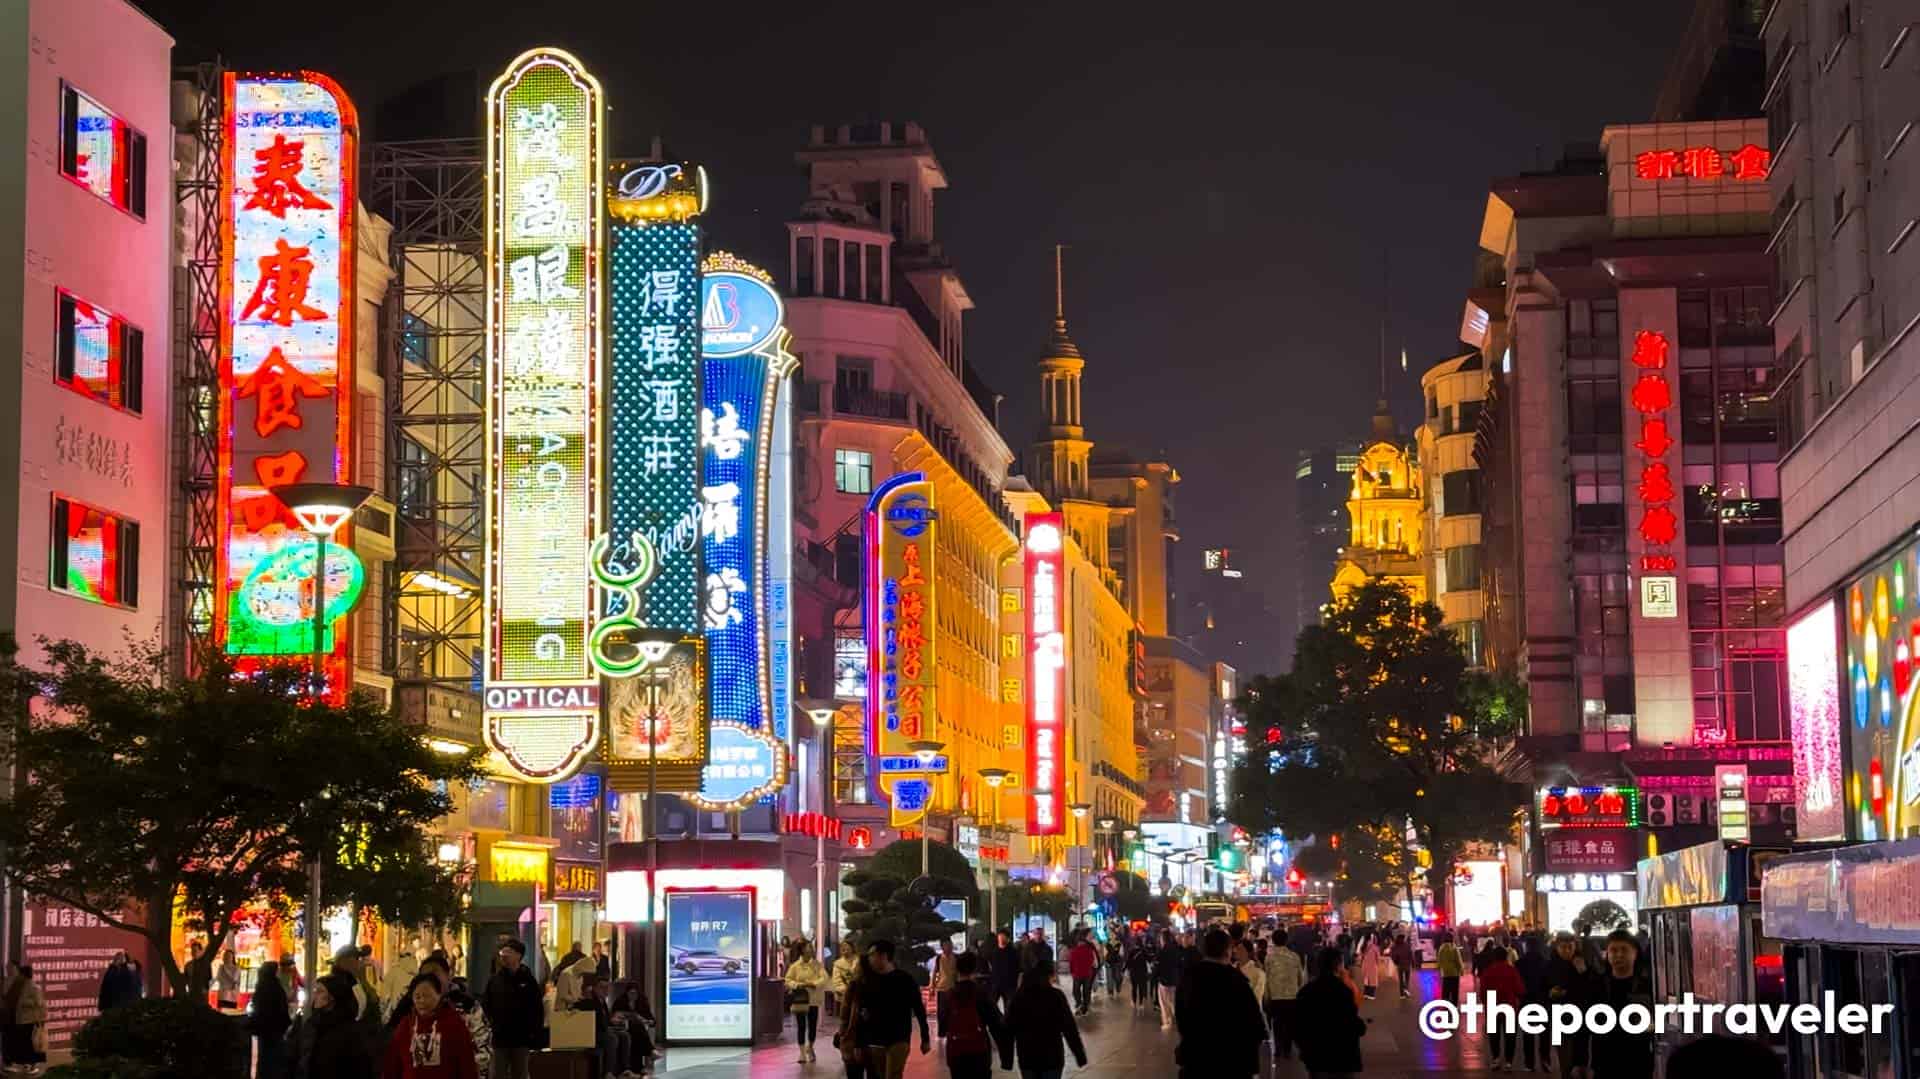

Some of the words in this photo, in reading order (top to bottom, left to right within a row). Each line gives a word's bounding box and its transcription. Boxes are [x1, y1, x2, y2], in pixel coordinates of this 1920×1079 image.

[238, 134, 335, 531] 泰康食品
[487, 687, 596, 710] OPTICAL
